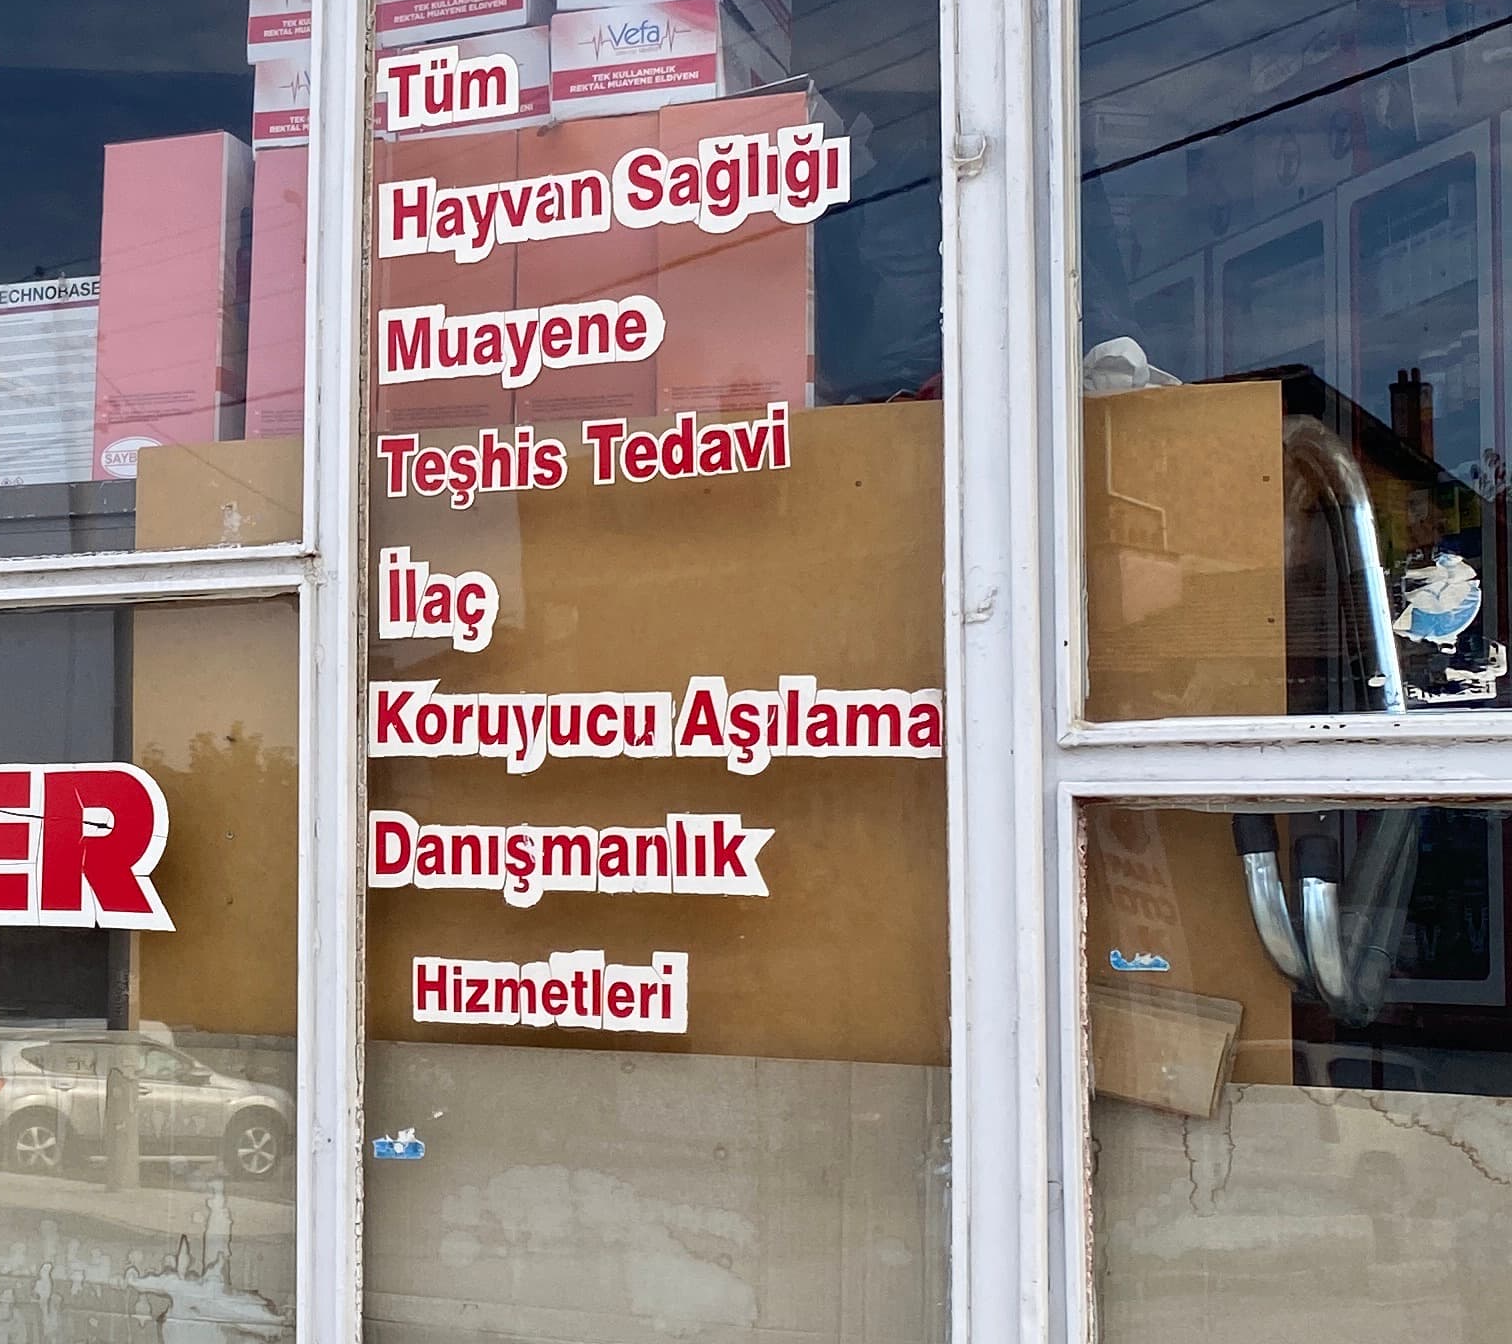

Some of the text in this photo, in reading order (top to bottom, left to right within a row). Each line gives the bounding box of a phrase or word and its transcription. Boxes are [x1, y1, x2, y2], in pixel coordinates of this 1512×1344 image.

[608, 19, 660, 47] Vefa
[389, 59, 507, 118] Tüm
[569, 83, 606, 93] REKTAL
[608, 77, 654, 89] MUAYENE
[592, 65, 676, 82] TEK KULLANIMLIK
[392, 134, 839, 248] Hayvan Sağlığı
[388, 307, 647, 378] Muayene
[381, 409, 787, 505] Teşhis Tedavi
[389, 554, 486, 641] İlaç
[377, 689, 942, 764] Koruyucu Aşılama
[375, 820, 747, 893] Danışmanlık
[417, 964, 673, 1019] Hizmetleri
